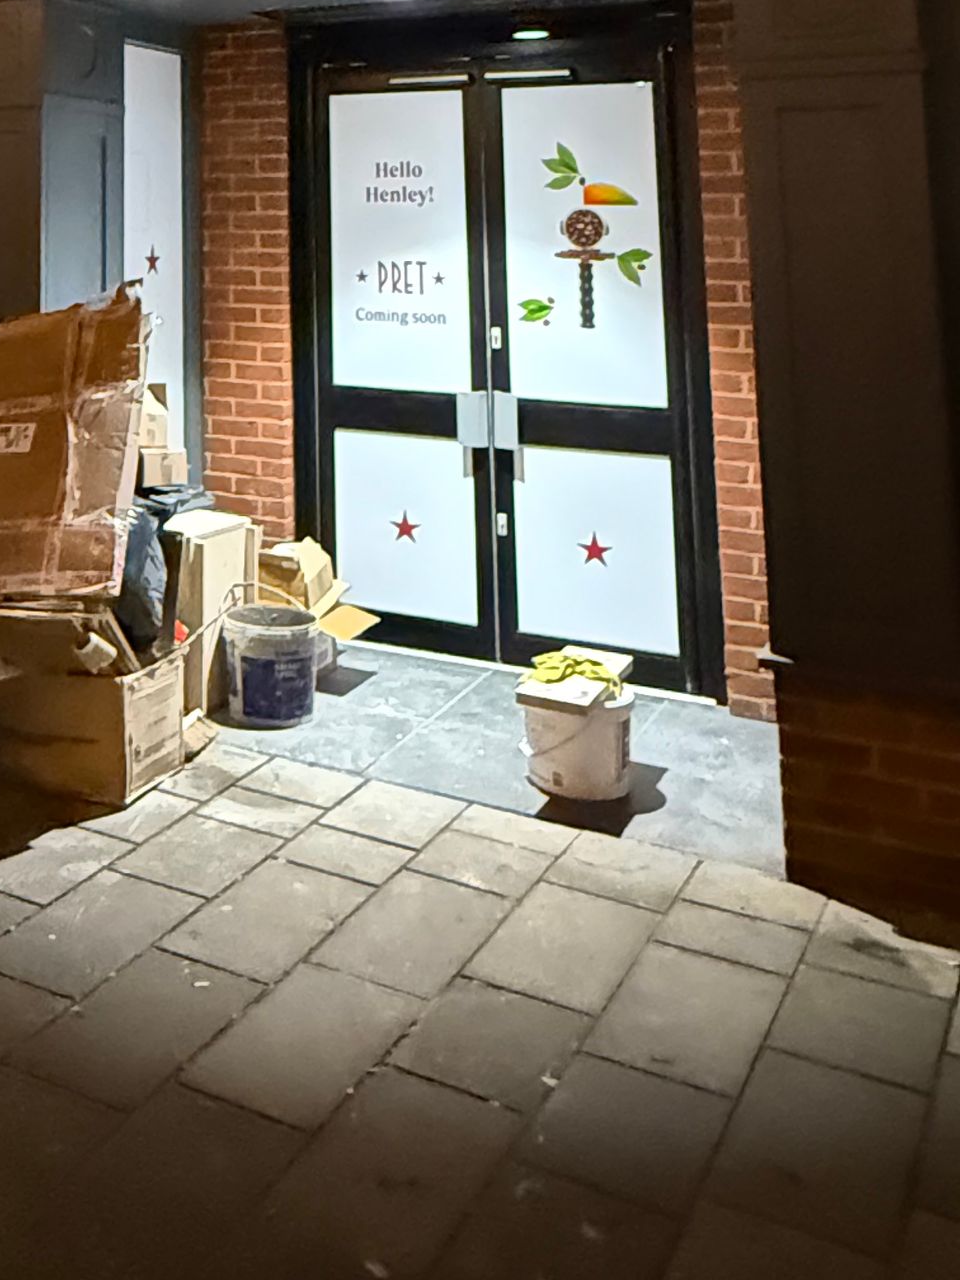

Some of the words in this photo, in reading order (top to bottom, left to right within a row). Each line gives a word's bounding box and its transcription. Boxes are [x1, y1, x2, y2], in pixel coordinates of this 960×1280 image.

[375, 161, 423, 179] Hello
[365, 186, 435, 207] Henley!
[377, 260, 427, 295] PRET
[355, 307, 408, 326] Coming
[412, 312, 447, 325] soon
